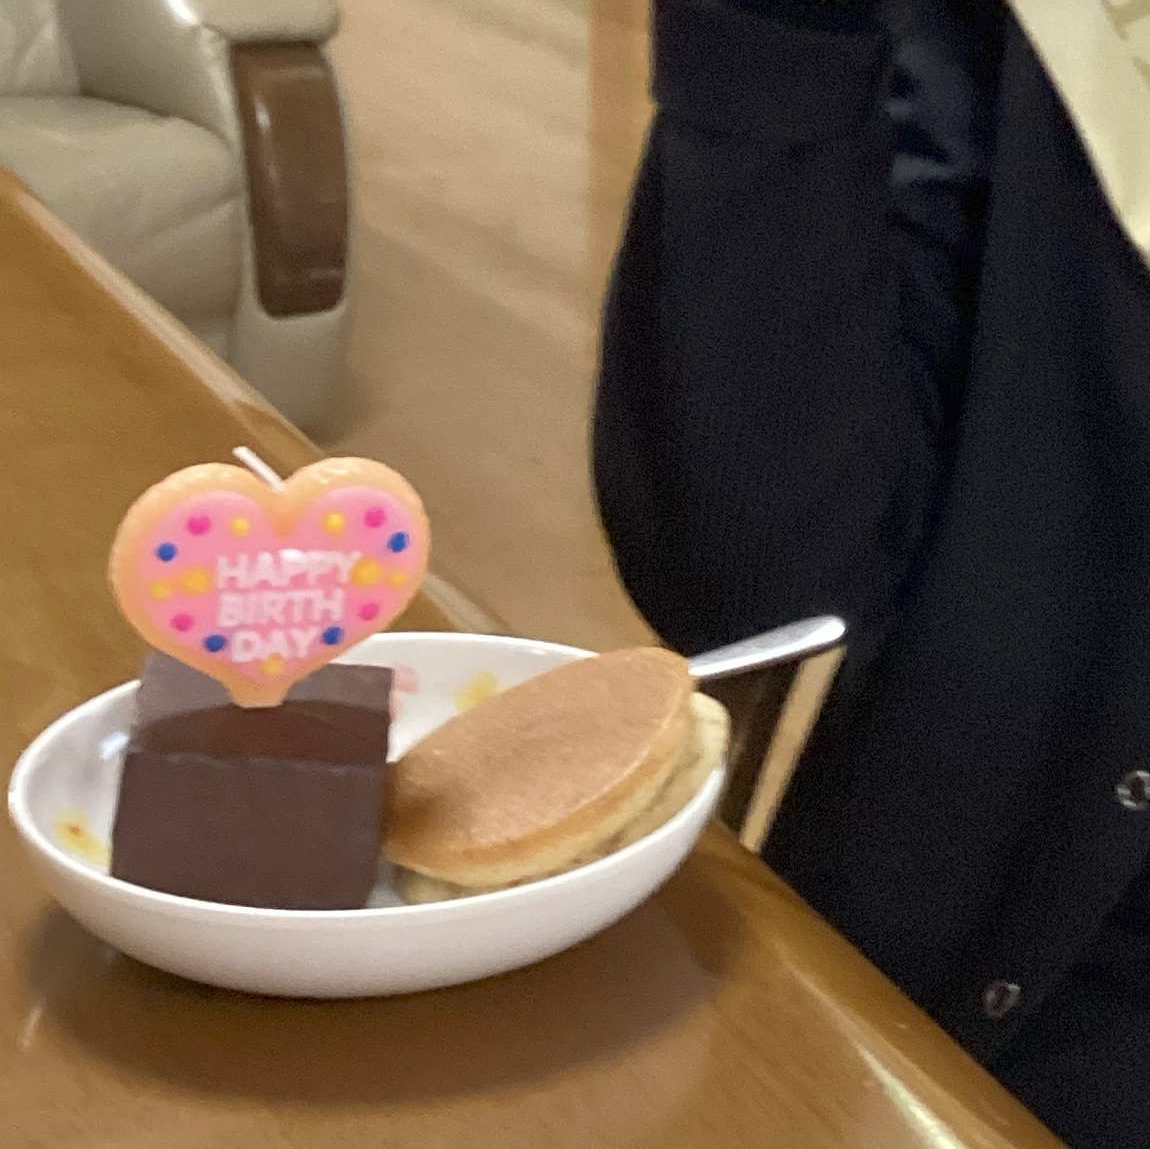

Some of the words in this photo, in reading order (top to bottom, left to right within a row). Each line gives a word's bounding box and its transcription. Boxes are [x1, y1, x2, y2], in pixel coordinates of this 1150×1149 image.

[216, 549, 362, 589] HAPPY
[216, 588, 345, 628] BIRTH
[231, 624, 322, 663] DAY
